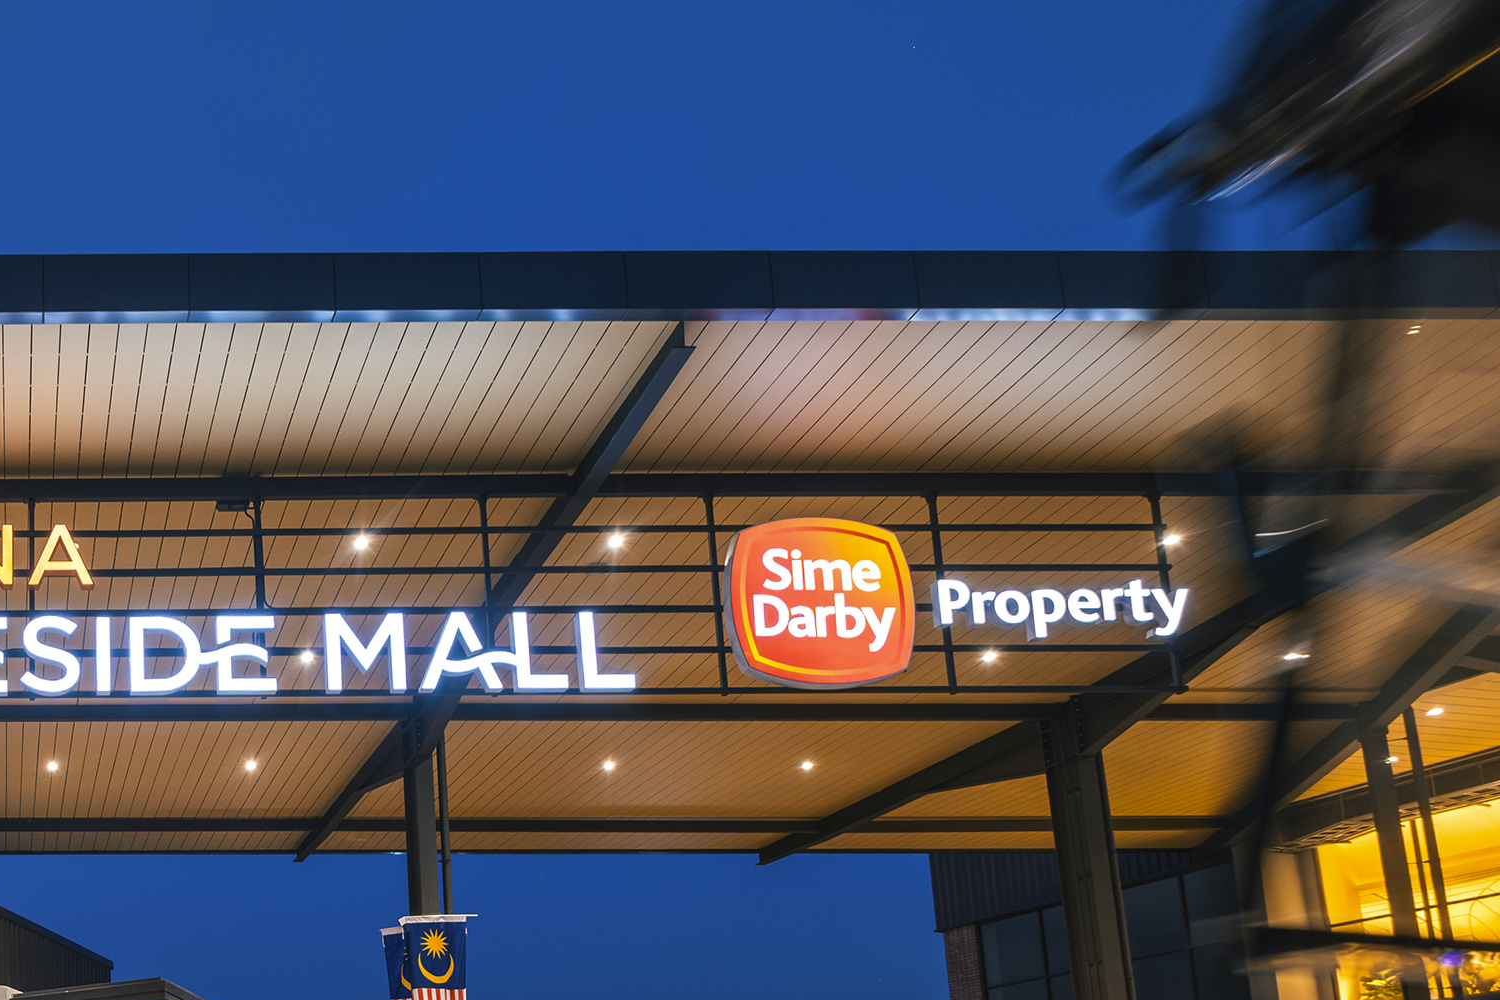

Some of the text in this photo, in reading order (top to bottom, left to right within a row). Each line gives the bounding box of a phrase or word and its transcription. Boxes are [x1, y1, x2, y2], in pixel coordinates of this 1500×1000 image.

[761, 547, 882, 592] Sime
[752, 592, 897, 653] Darby
[934, 578, 1189, 639] Property
[323, 611, 637, 694] MALL
